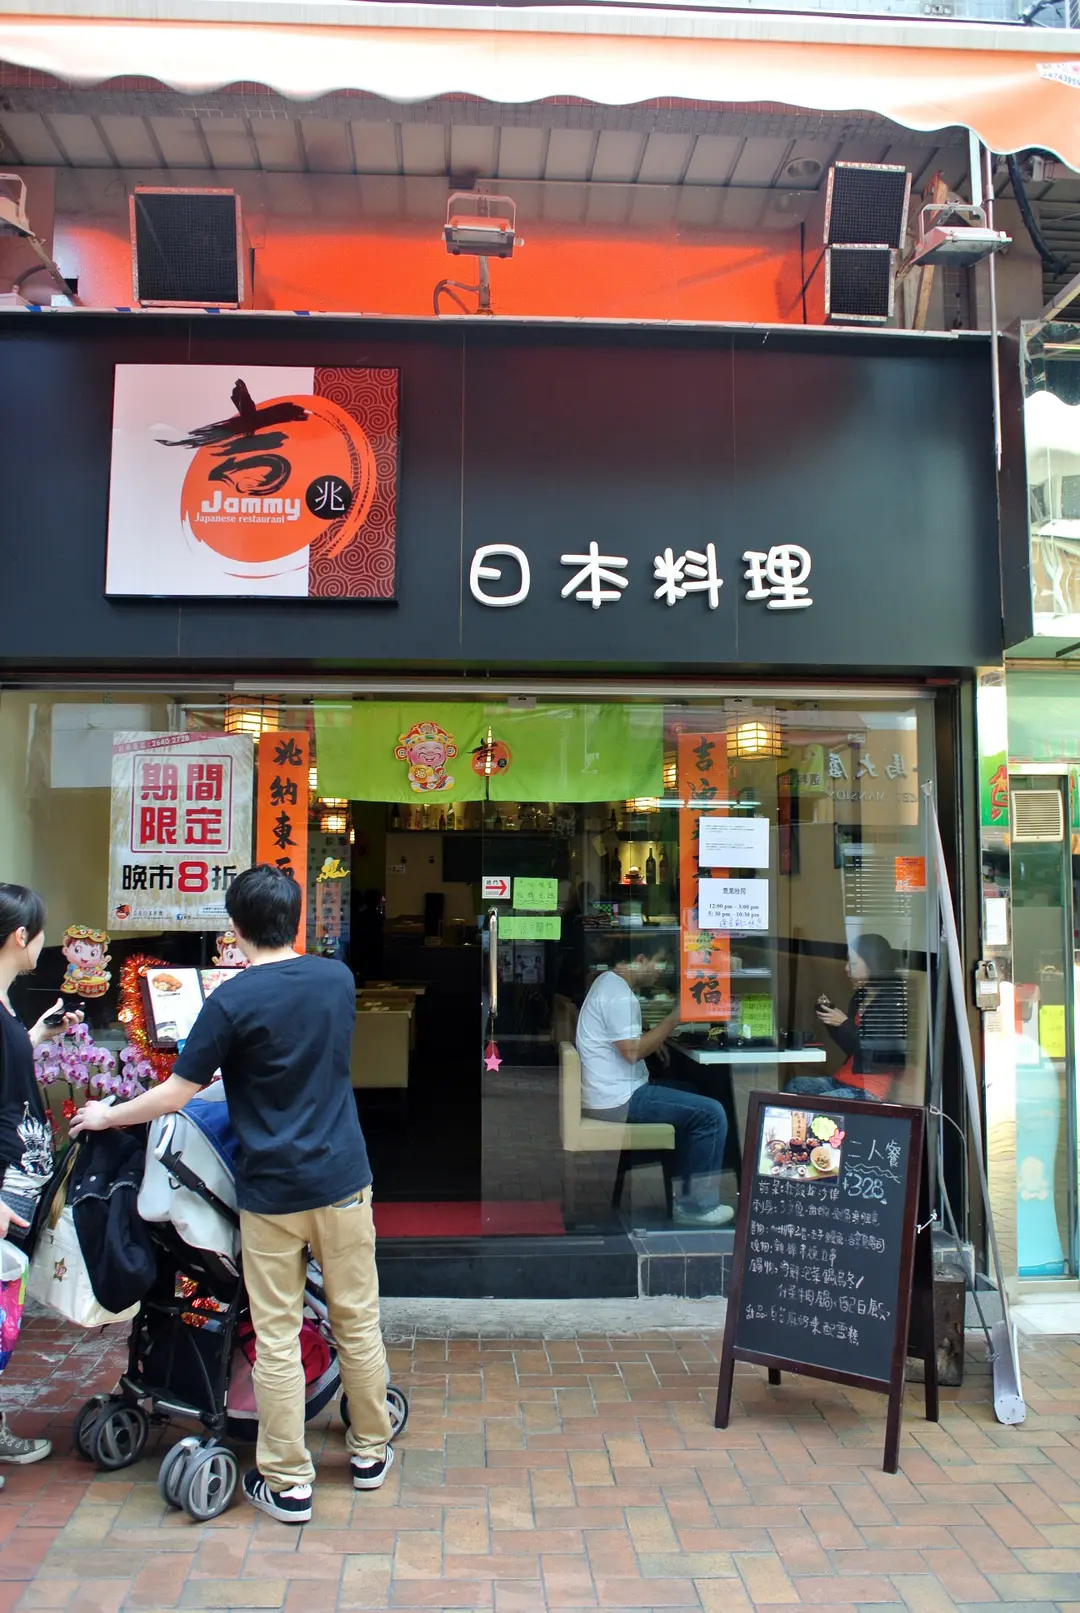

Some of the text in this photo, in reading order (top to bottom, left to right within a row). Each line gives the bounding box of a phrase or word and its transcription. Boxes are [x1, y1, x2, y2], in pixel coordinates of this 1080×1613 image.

[201, 490, 301, 521] Jammy
[314, 481, 345, 511] 兆
[194, 514, 285, 524] Japanese restaurant
[469, 541, 813, 610] 日本料理
[151, 738, 170, 748] 2640
[171, 734, 190, 744] 2728
[141, 763, 223, 801] 期間
[140, 807, 222, 845] 限定
